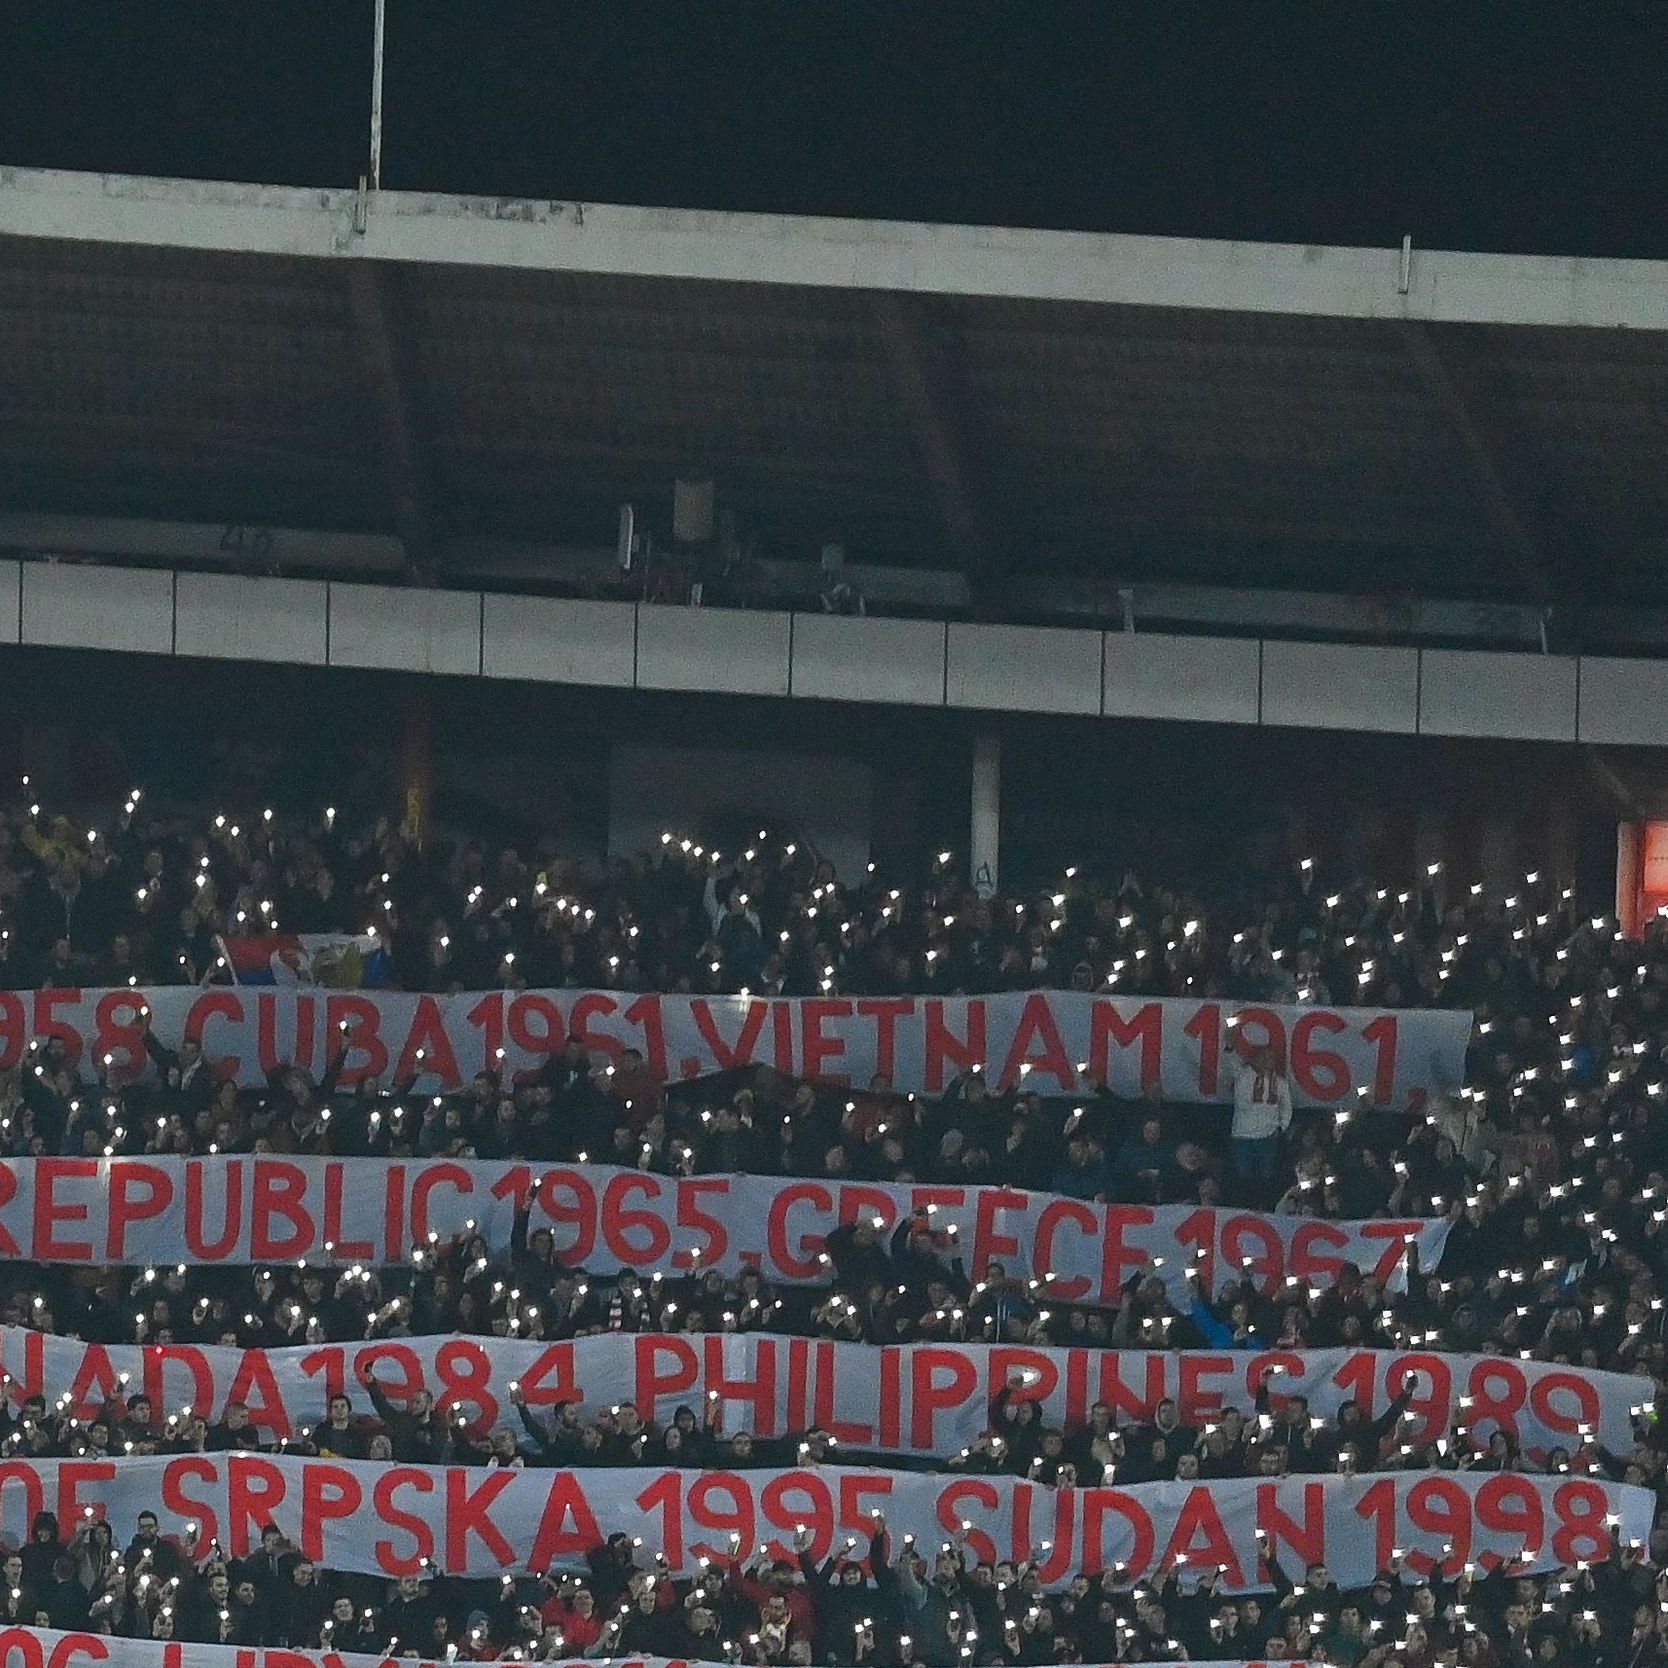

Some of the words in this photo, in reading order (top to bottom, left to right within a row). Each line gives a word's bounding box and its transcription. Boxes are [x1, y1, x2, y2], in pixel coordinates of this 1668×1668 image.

[690, 993, 1163, 1095] VIETNAM
[635, 1334, 1306, 1450] PHILIPPINES
[162, 1455, 607, 1576] SRPSKA
[936, 1478, 1325, 1588] SUDAN
